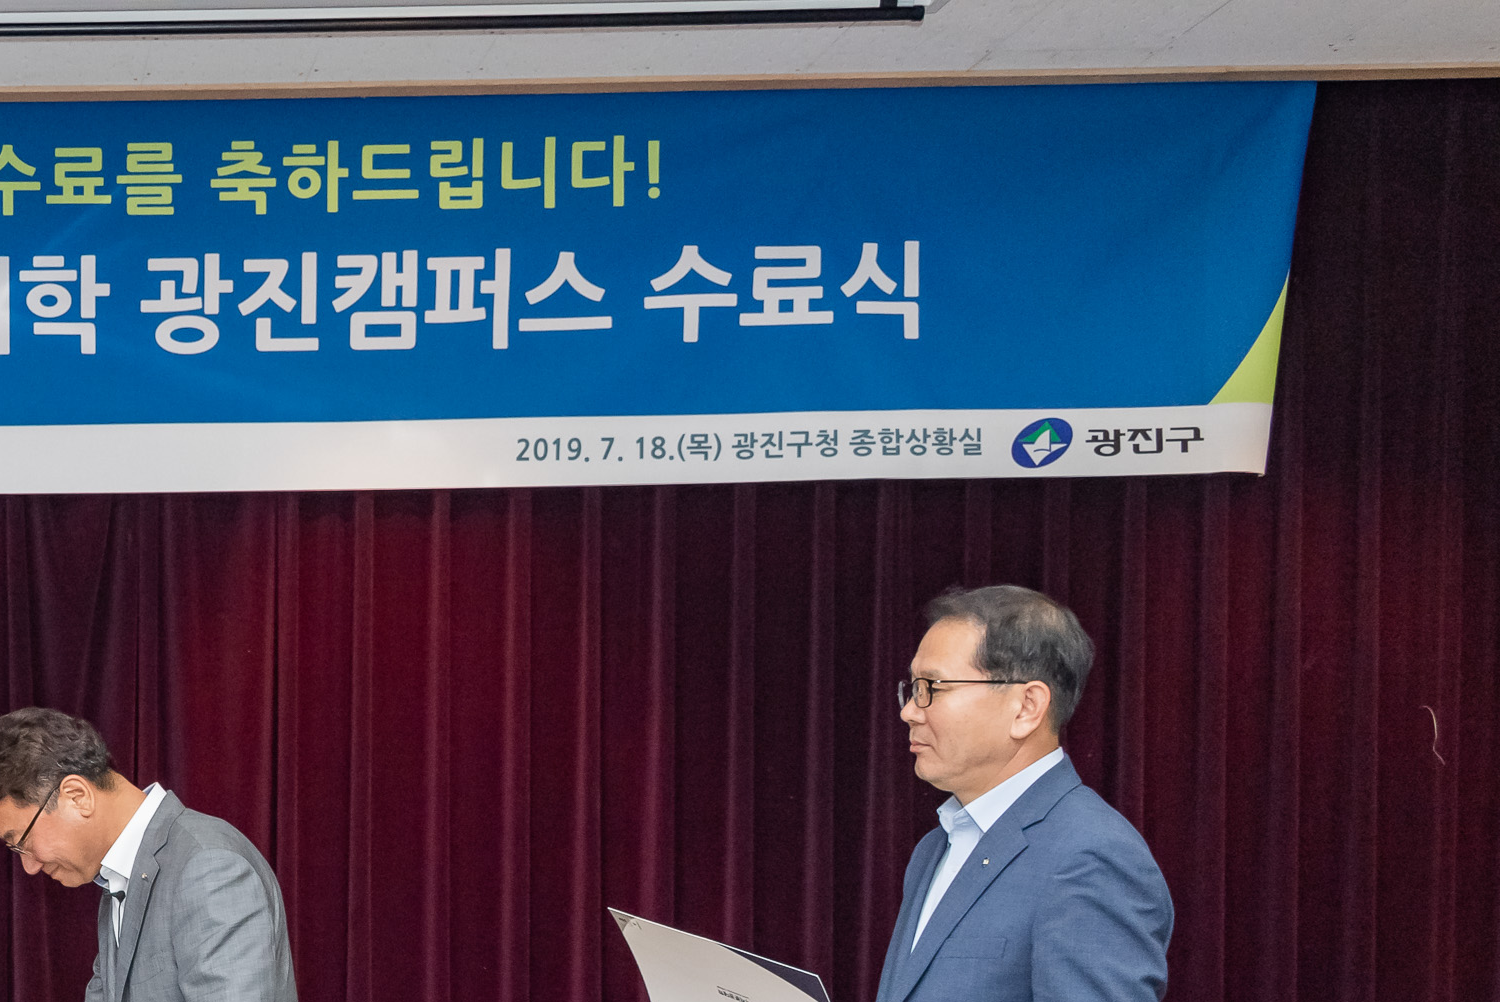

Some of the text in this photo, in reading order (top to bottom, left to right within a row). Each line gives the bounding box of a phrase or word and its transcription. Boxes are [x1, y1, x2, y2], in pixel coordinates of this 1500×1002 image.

[210, 135, 662, 215] 축하드립니다!
[140, 247, 614, 355] 광진캠퍼스
[643, 239, 922, 344] 수료식
[516, 437, 591, 462] 2019.
[600, 437, 624, 462] 7.
[731, 430, 840, 460] 광진구청
[849, 426, 983, 457] 종합상황실
[1085, 426, 1205, 457] 광진구
